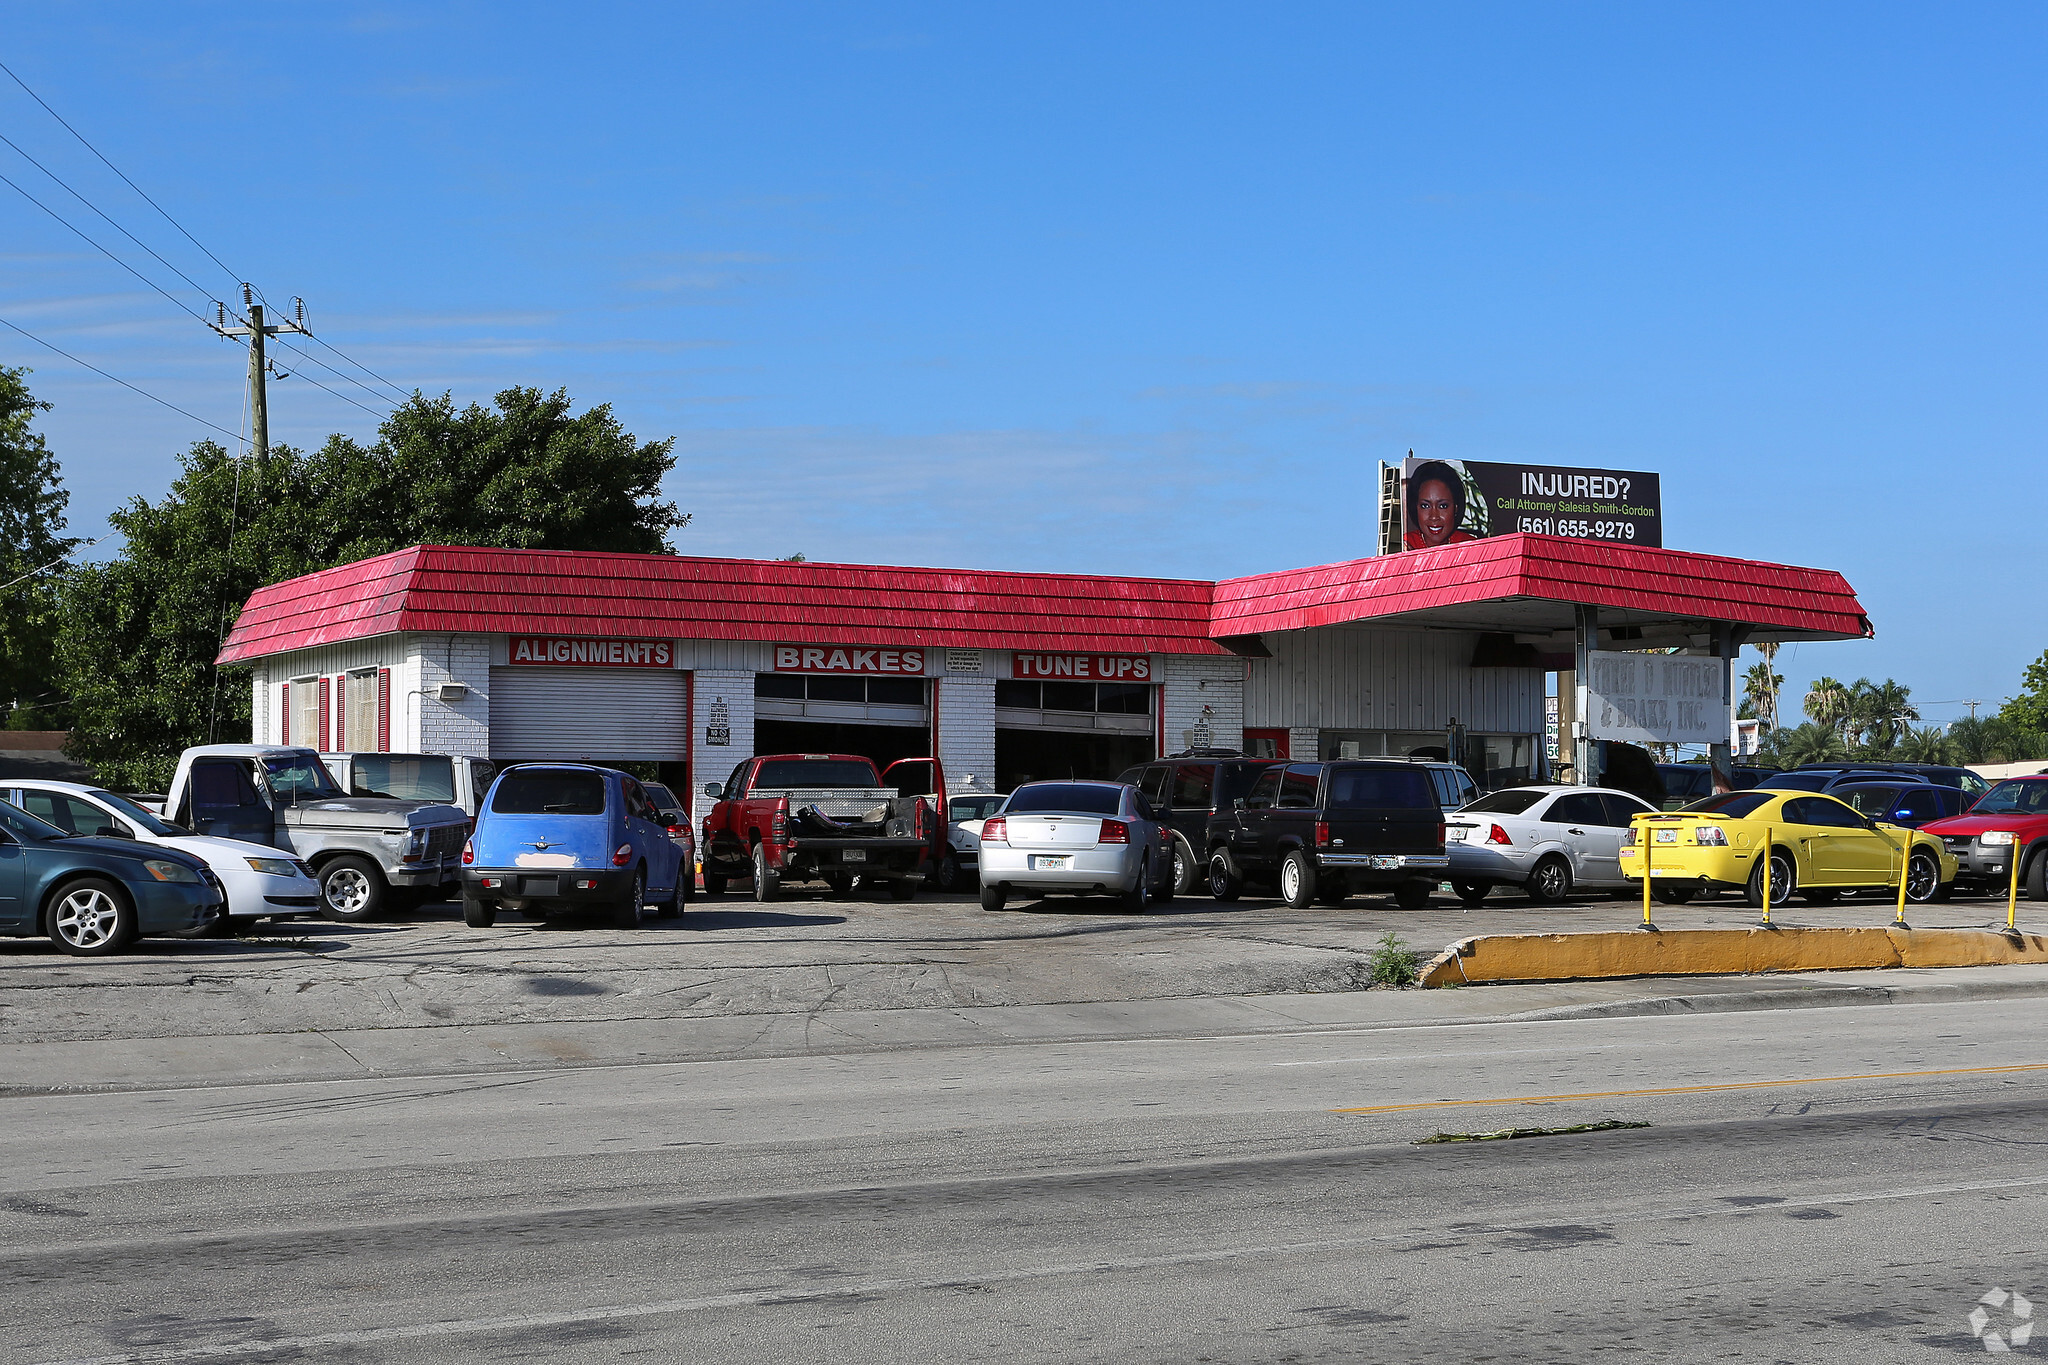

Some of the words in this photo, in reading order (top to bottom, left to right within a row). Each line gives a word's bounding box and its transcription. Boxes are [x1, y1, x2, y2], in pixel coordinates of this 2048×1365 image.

[1521, 472, 1631, 500] INJURED?
[1497, 497, 1515, 509] Call
[1516, 499, 1557, 513] Attorney
[1558, 501, 1591, 513] Salesia
[1592, 502, 1655, 517] Smith-Gordon
[1517, 515, 1555, 536] (561)
[1557, 519, 1636, 540] 655-9279
[515, 639, 670, 664] ALIGNMENTS
[777, 647, 923, 672] BRAKES
[1017, 654, 1090, 677] TUNE
[1098, 657, 1149, 678] UPS
[1600, 698, 1612, 728] &
